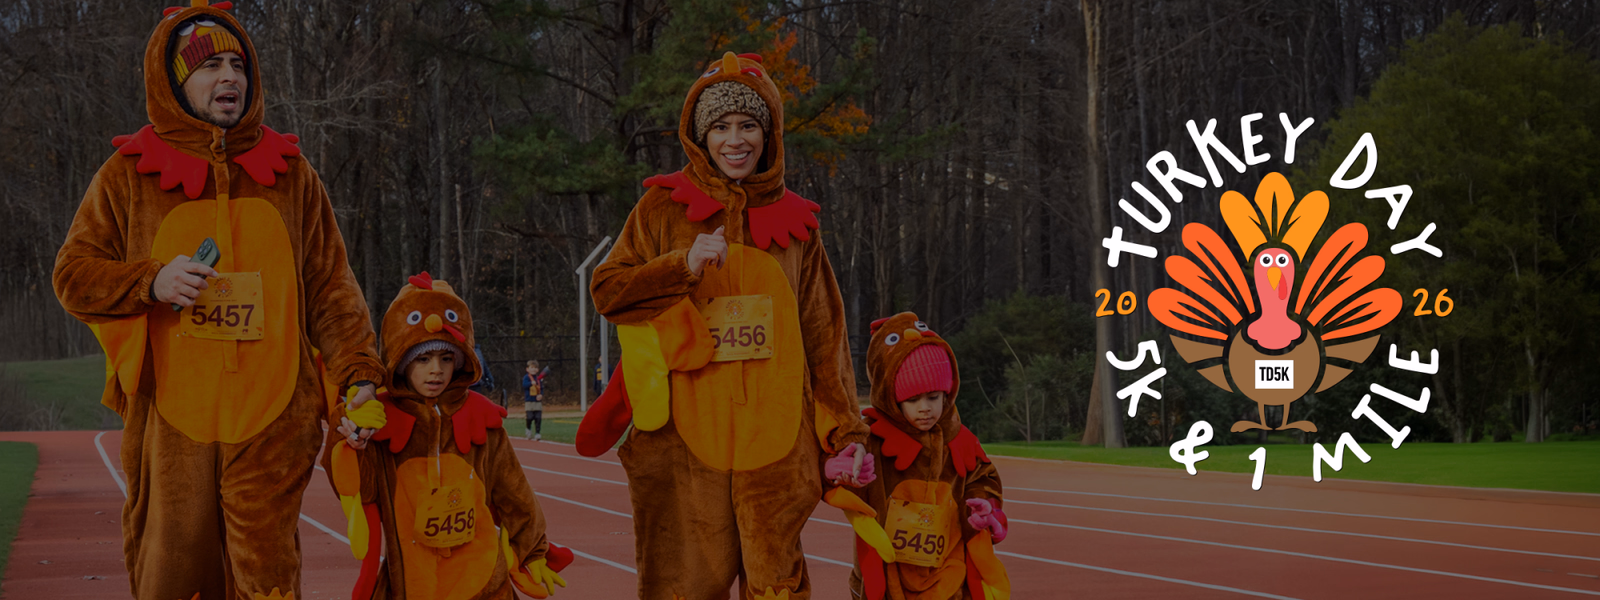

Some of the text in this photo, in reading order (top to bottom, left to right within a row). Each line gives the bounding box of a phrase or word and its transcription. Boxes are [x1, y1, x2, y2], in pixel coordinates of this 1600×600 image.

[191, 304, 254, 327] 5457
[708, 324, 766, 350] 5456
[424, 507, 475, 537] 5458
[892, 529, 945, 556] 5459
